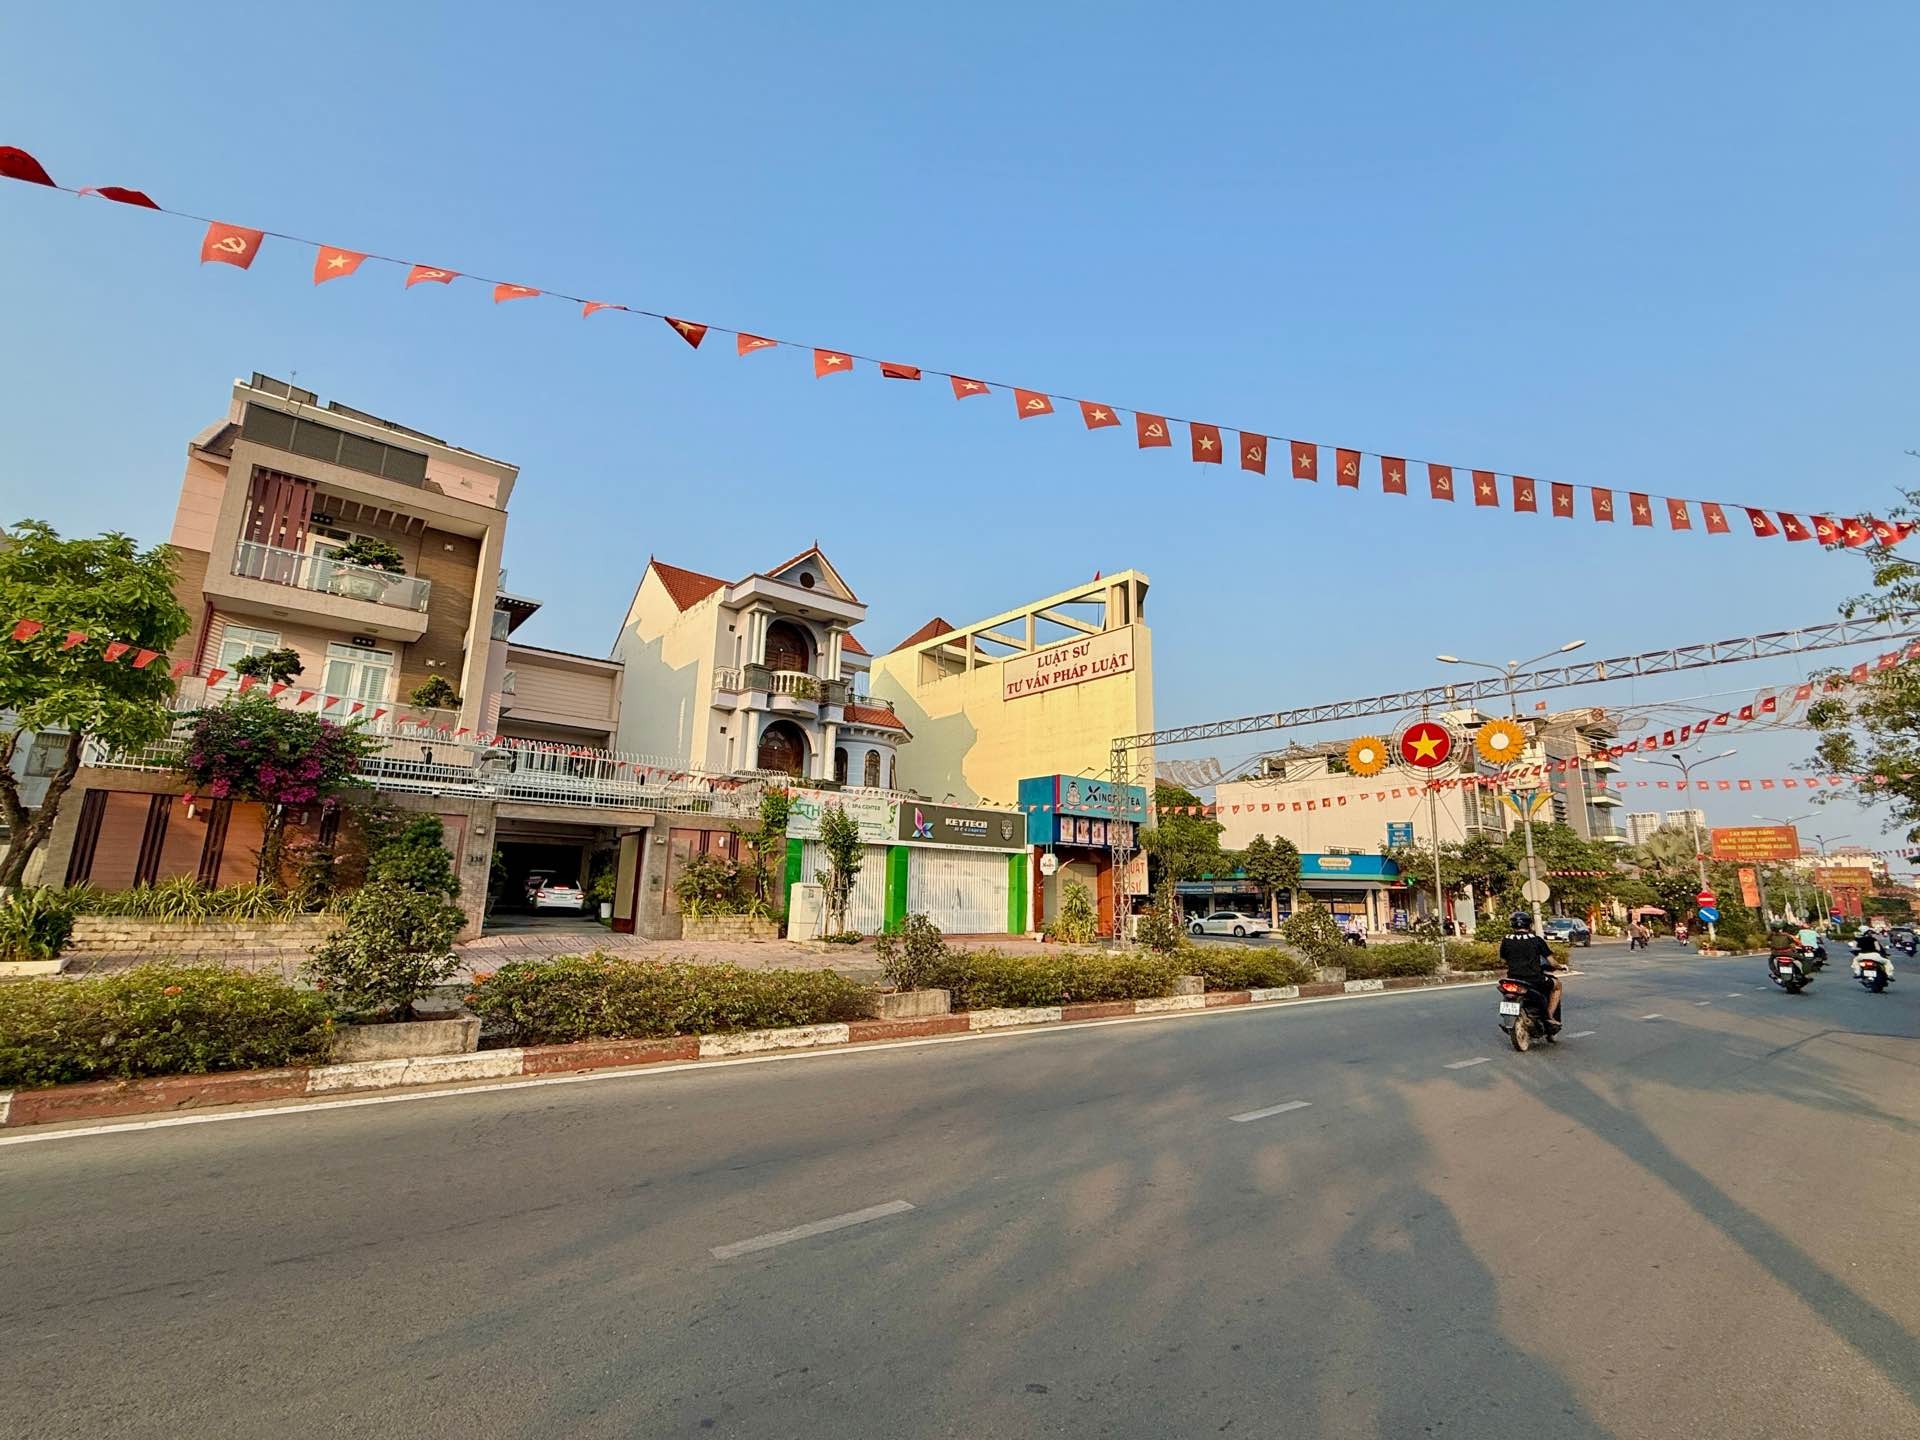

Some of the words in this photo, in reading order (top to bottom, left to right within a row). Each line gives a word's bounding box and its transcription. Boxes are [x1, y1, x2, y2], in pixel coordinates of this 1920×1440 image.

[1037, 649, 1069, 668] LUẬT
[1072, 641, 1091, 659] SƯ
[1006, 678, 1023, 694] TƯ
[1053, 662, 1088, 683] PHÁP
[1091, 653, 1129, 673] LUẬT
[945, 817, 988, 829] KEYTECH
